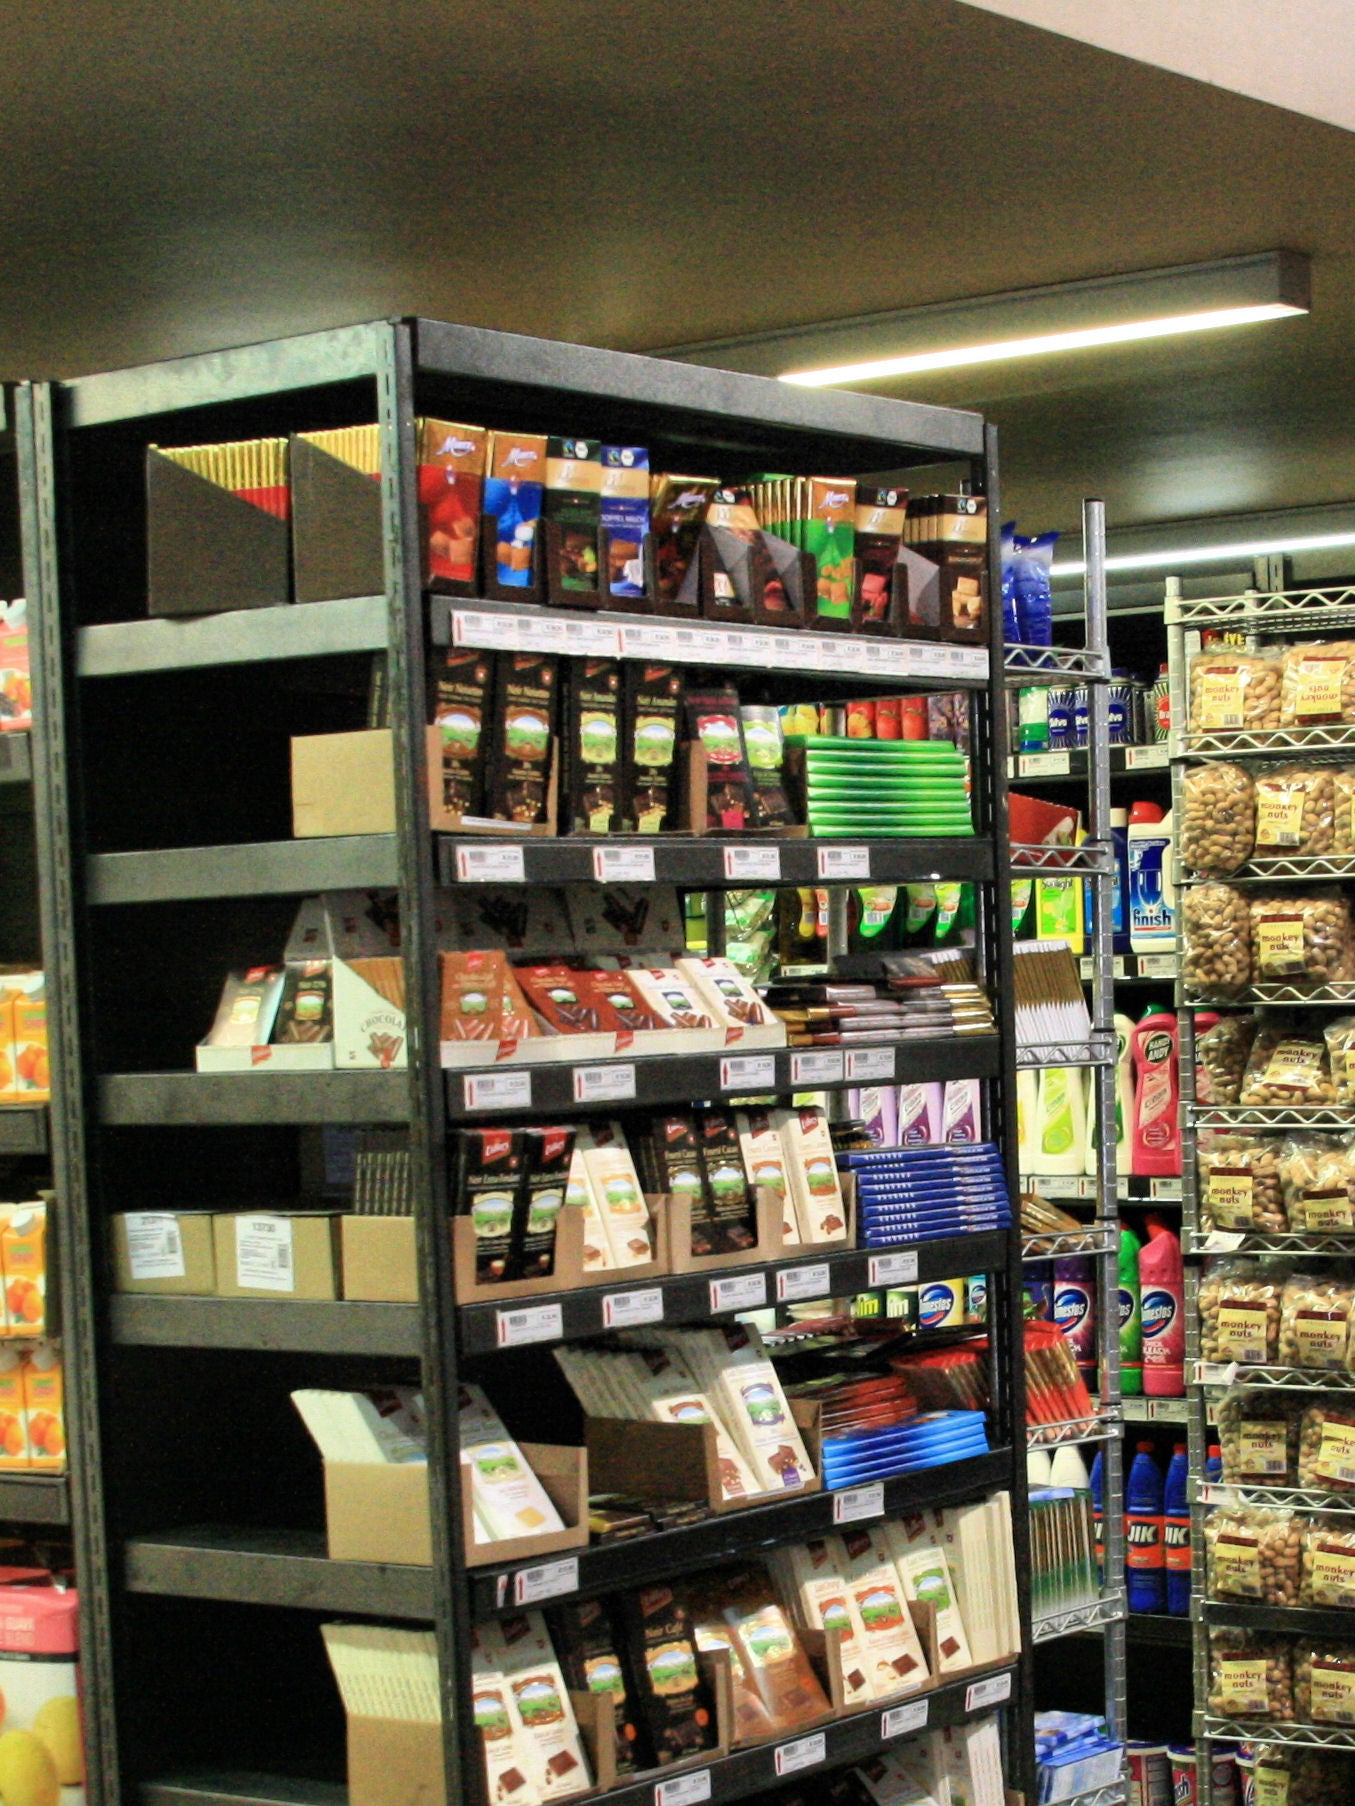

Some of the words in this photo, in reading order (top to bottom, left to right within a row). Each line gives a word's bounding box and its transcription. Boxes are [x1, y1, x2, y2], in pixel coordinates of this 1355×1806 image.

[1133, 908, 1171, 926] finish
[1148, 1048, 1169, 1061] ANDY
[1211, 1187, 1248, 1198] monkey
[1307, 1209, 1347, 1220] monkey
[1220, 1320, 1263, 1331] monkey
[1229, 1329, 1253, 1339] nuts
[1300, 1330, 1342, 1342] monkey
[1308, 1339, 1333, 1349] nuts
[1127, 1525, 1157, 1543] JIK
[1315, 1565, 1355, 1578] monkey
[1323, 1574, 1346, 1584] nuts
[1224, 1671, 1262, 1681] monkey
[1313, 1681, 1353, 1693] monkey
[1322, 1690, 1343, 1699] nuts
